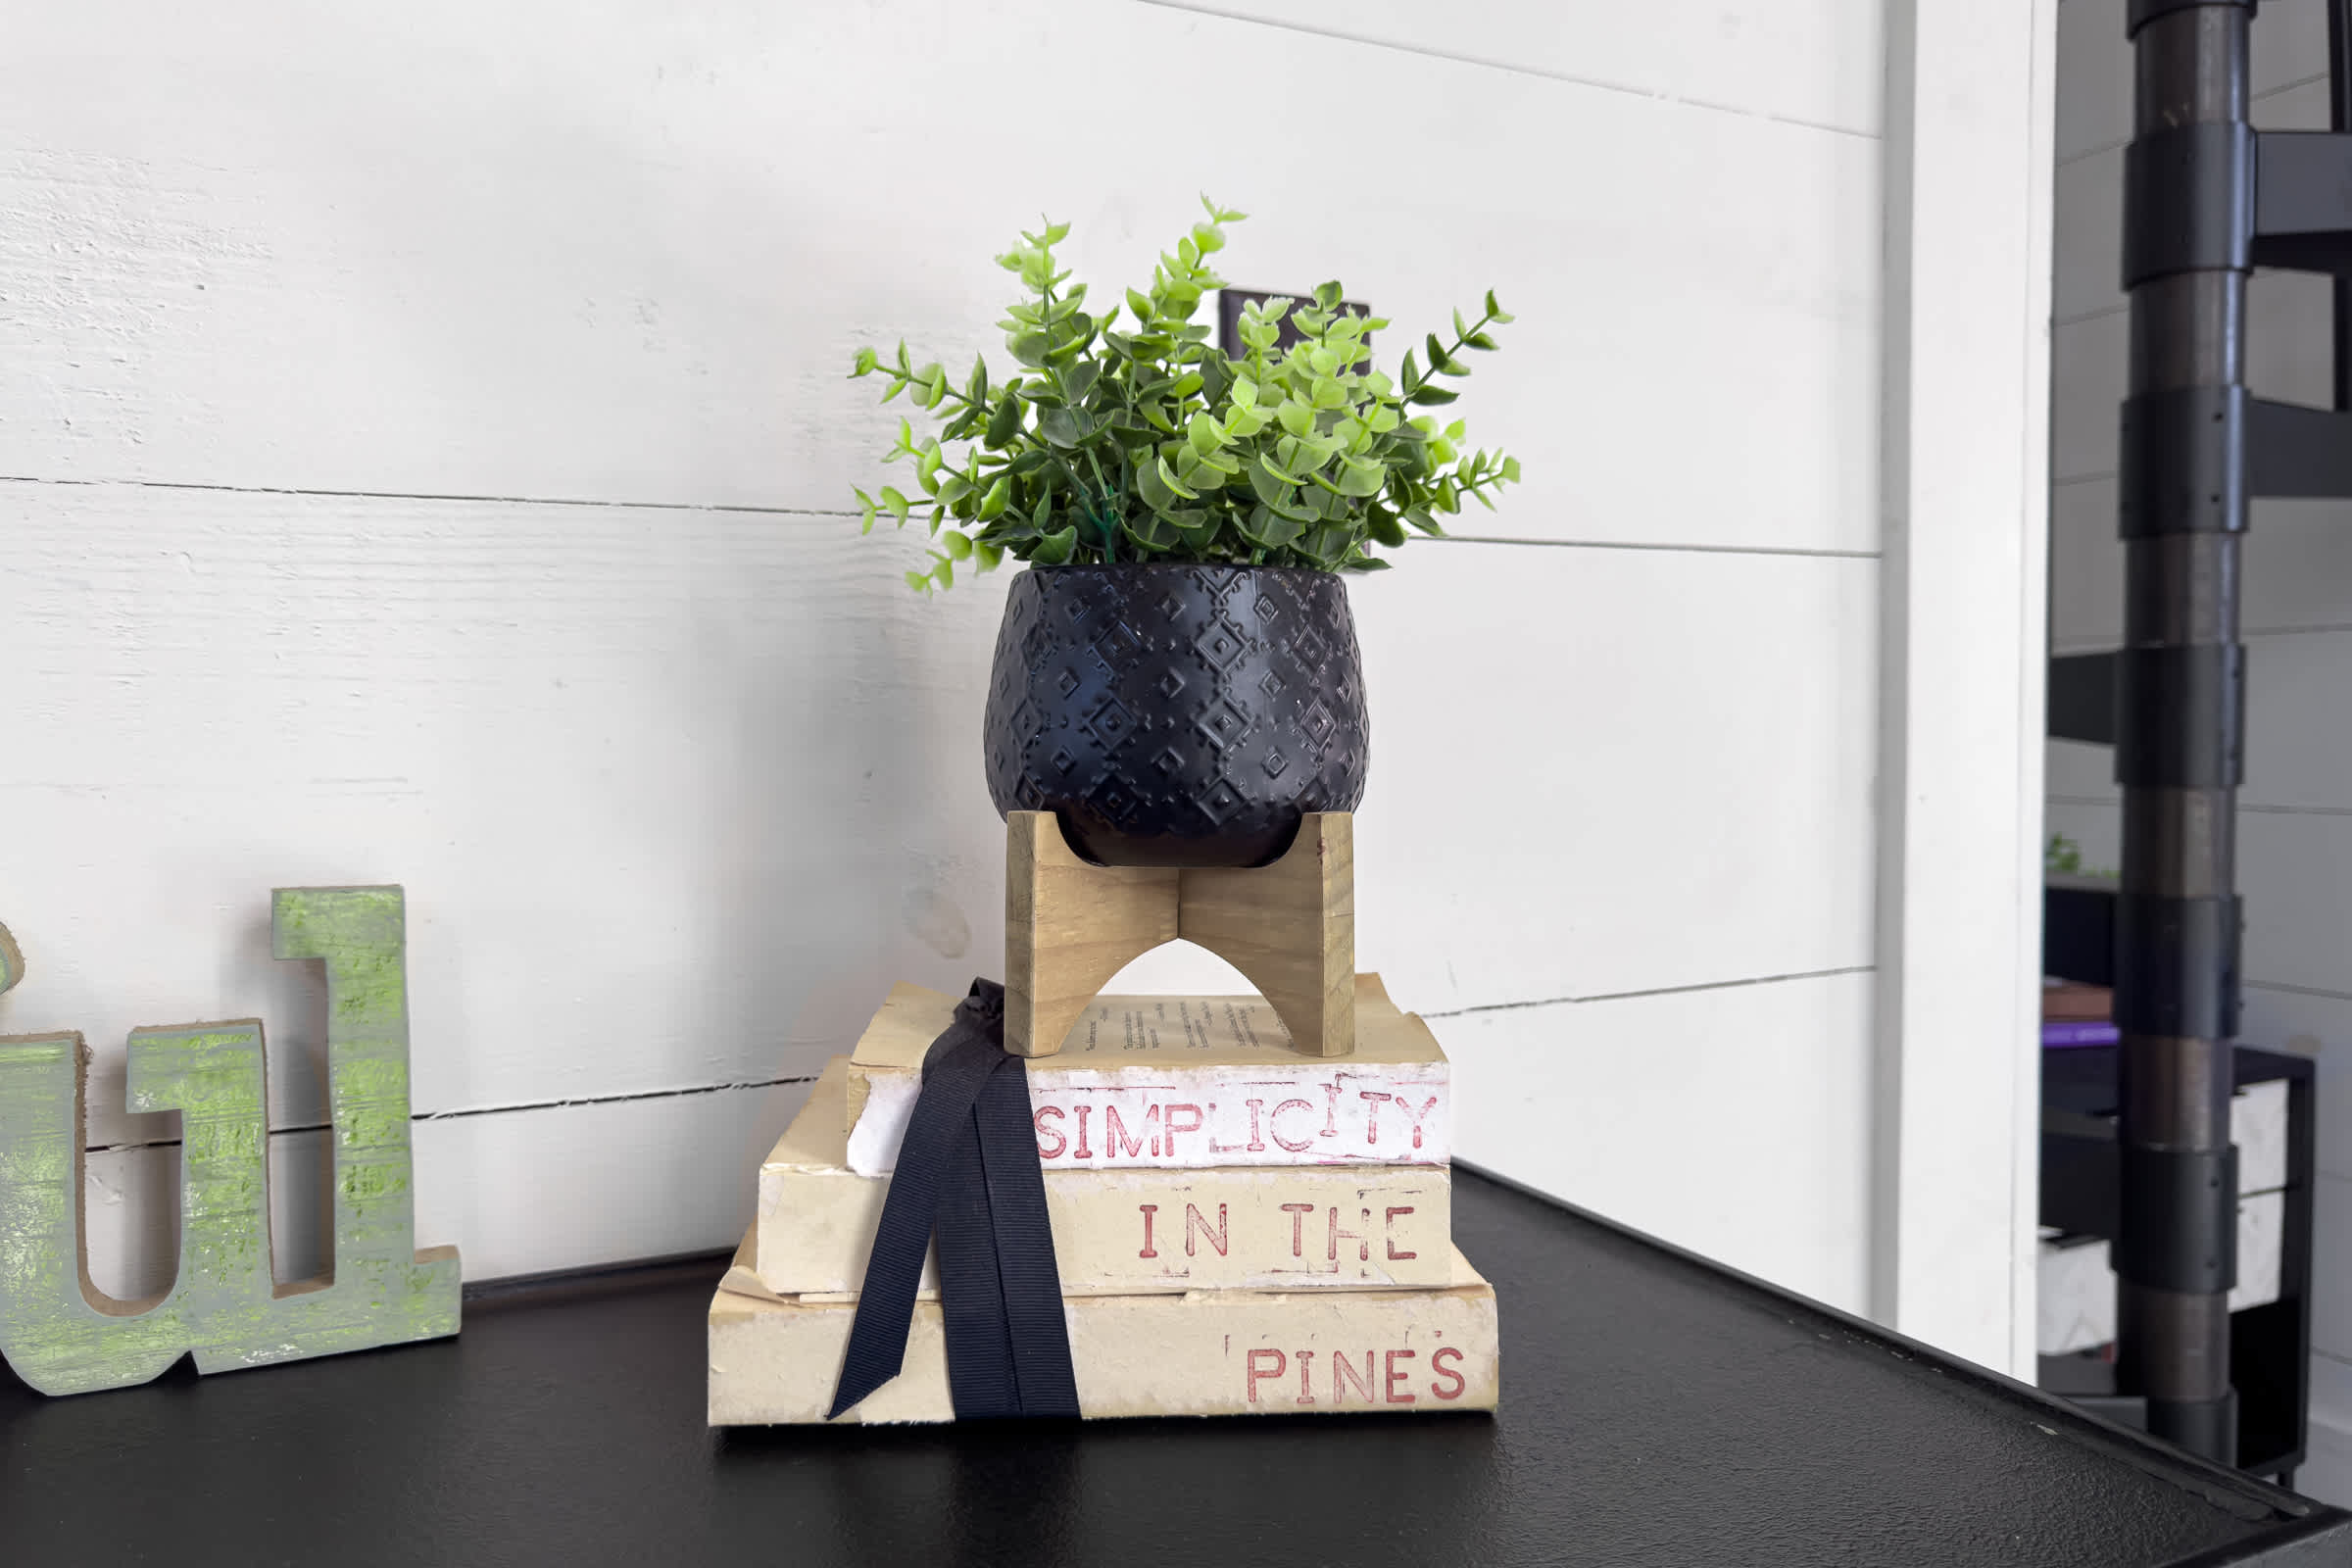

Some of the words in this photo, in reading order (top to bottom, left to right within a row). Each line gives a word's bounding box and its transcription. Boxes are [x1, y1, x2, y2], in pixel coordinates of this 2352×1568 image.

[0, 885, 462, 1396] ul
[1033, 1085, 1437, 1159] SIMPLICITY
[1139, 1203, 1228, 1258] IN
[1280, 1203, 1417, 1261] THE
[1247, 1347, 1466, 1403] PINES
